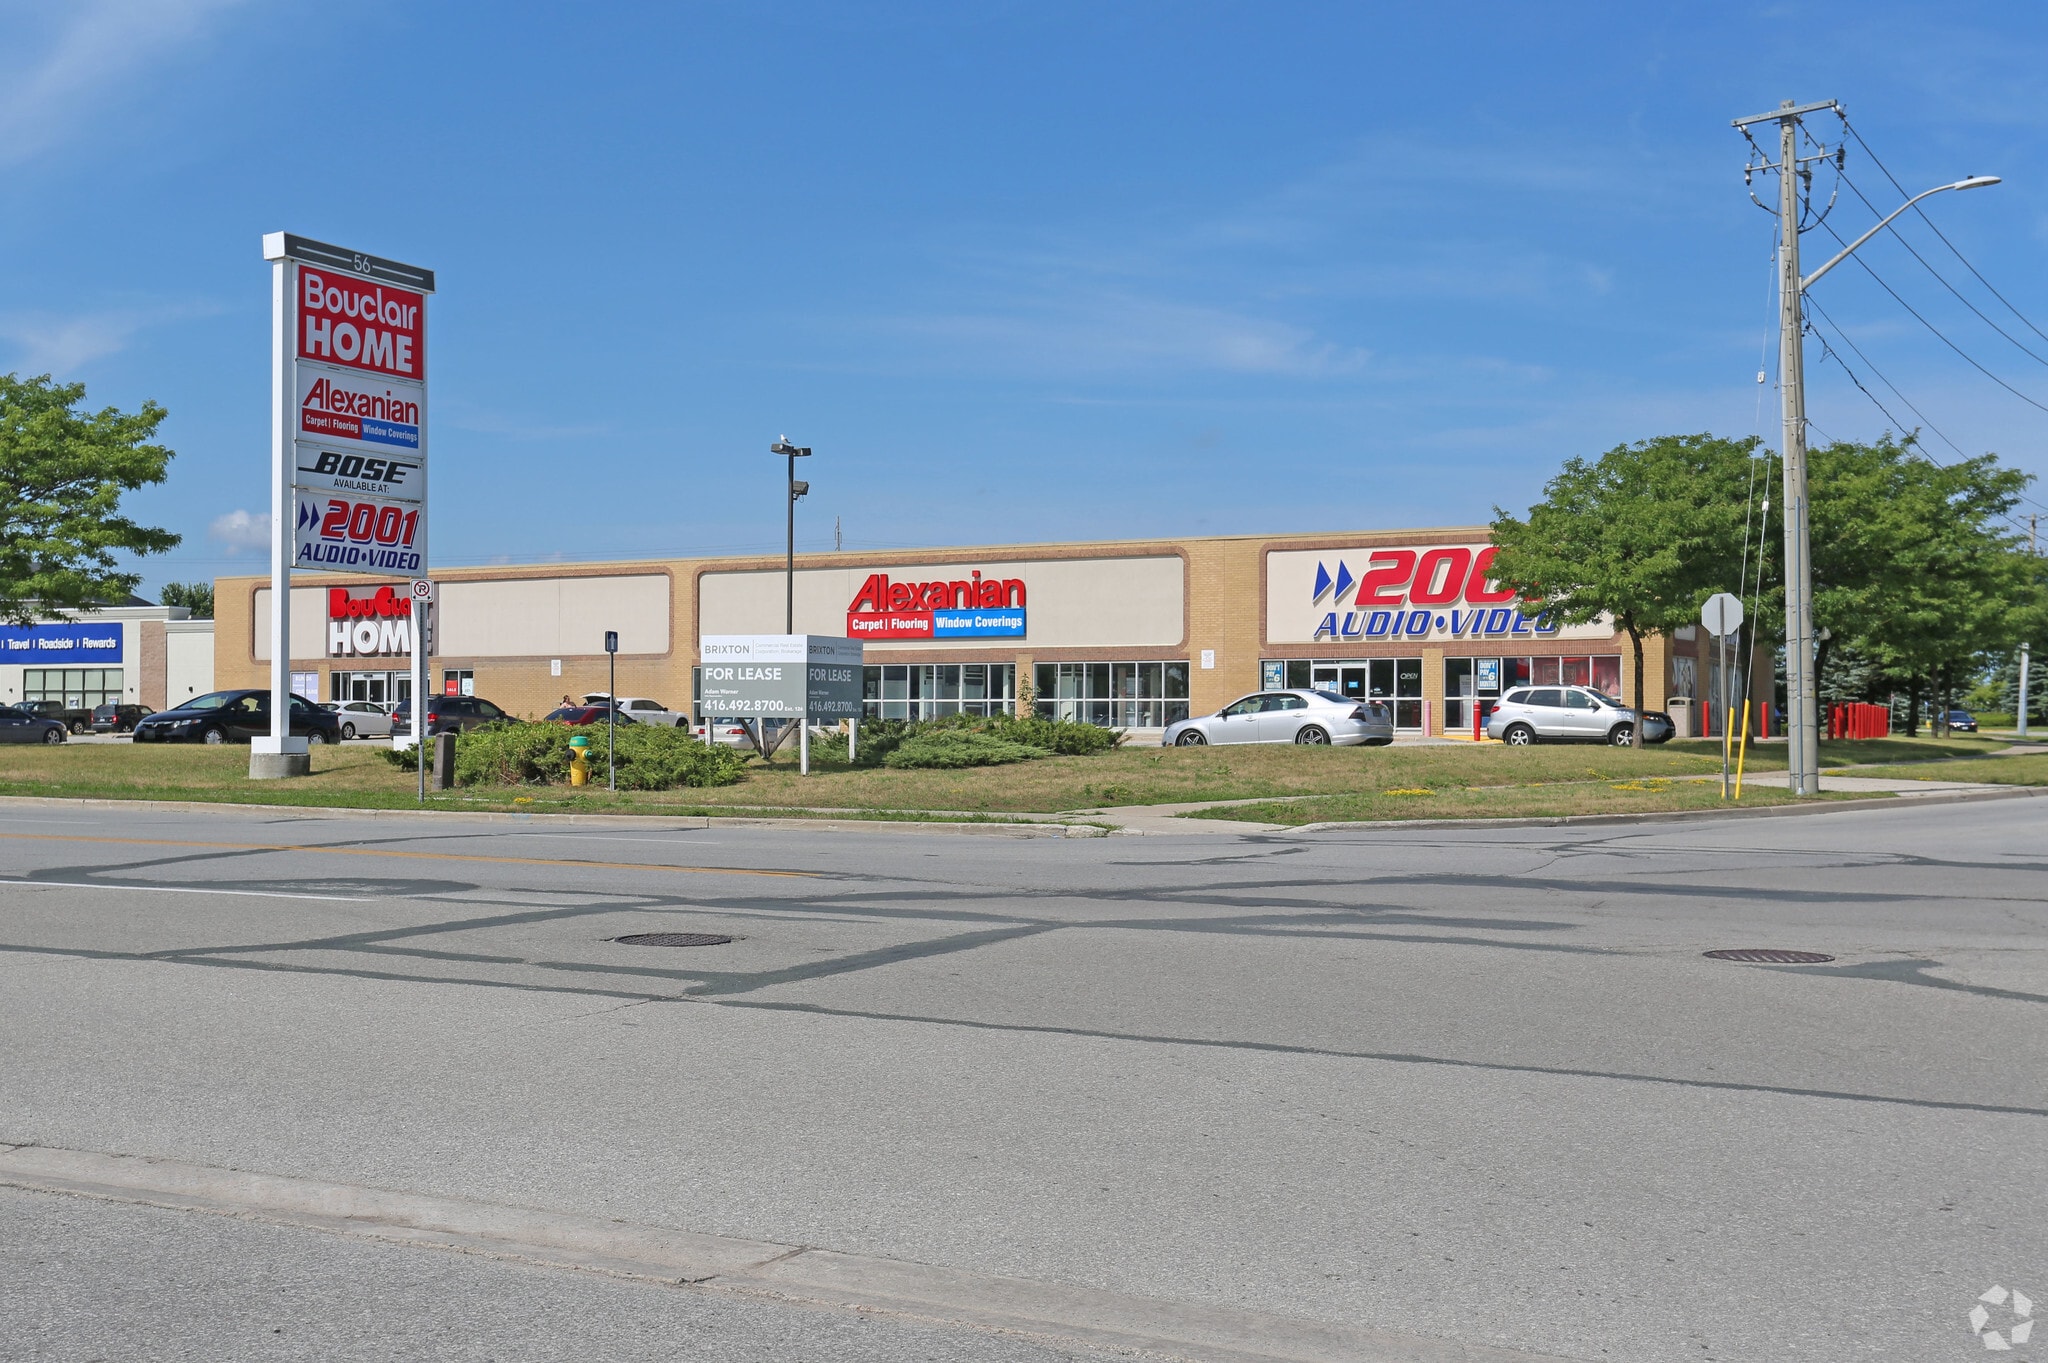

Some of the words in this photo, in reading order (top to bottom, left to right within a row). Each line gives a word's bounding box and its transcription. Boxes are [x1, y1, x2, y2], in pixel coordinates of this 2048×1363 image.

[354, 254, 371, 273] 56
[305, 273, 417, 330] Bouclair
[306, 315, 412, 373] HOME
[303, 378, 419, 425] Alexanian
[306, 415, 328, 428] Carpet
[333, 419, 359, 434] Flooring
[363, 424, 387, 437] Window
[388, 428, 418, 442] Coverings
[298, 451, 418, 484] BOSE
[334, 478, 377, 492] AVAILABLE
[320, 499, 419, 549] 2001
[848, 570, 1026, 612] Alexanian
[852, 618, 884, 632] Carpet
[891, 618, 929, 631] Flooring
[936, 616, 972, 629] Window
[975, 615, 1022, 629] Coverings
[7, 639, 30, 650] Travel
[39, 638, 74, 649] Roadside
[83, 637, 117, 649] Rewards
[704, 644, 750, 654] BRIXTON
[808, 645, 835, 655] BRIXTON
[705, 667, 734, 681] FOR
[738, 667, 782, 681] LEASE
[809, 668, 827, 681] FOR
[828, 669, 852, 682] LEASE
[1274, 674, 1281, 682] 6
[1400, 672, 1419, 680] OPEN
[1488, 672, 1496, 681] 6
[704, 699, 784, 711] 416.492.8700
[808, 700, 853, 712] 416.492.8700
